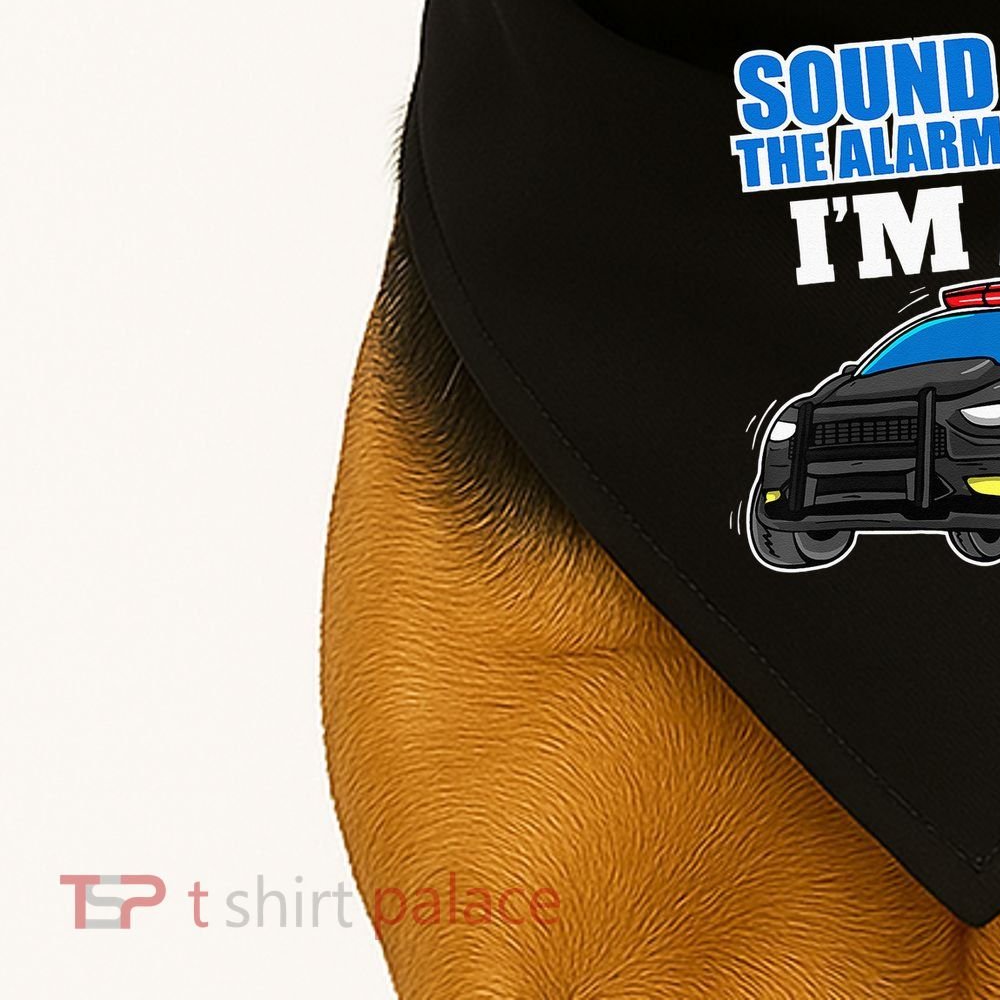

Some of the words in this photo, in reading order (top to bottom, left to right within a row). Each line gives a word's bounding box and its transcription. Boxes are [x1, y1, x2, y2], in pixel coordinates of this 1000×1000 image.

[736, 35, 998, 131] SOUND
[735, 132, 830, 188] THE
[789, 185, 970, 285] I'M
